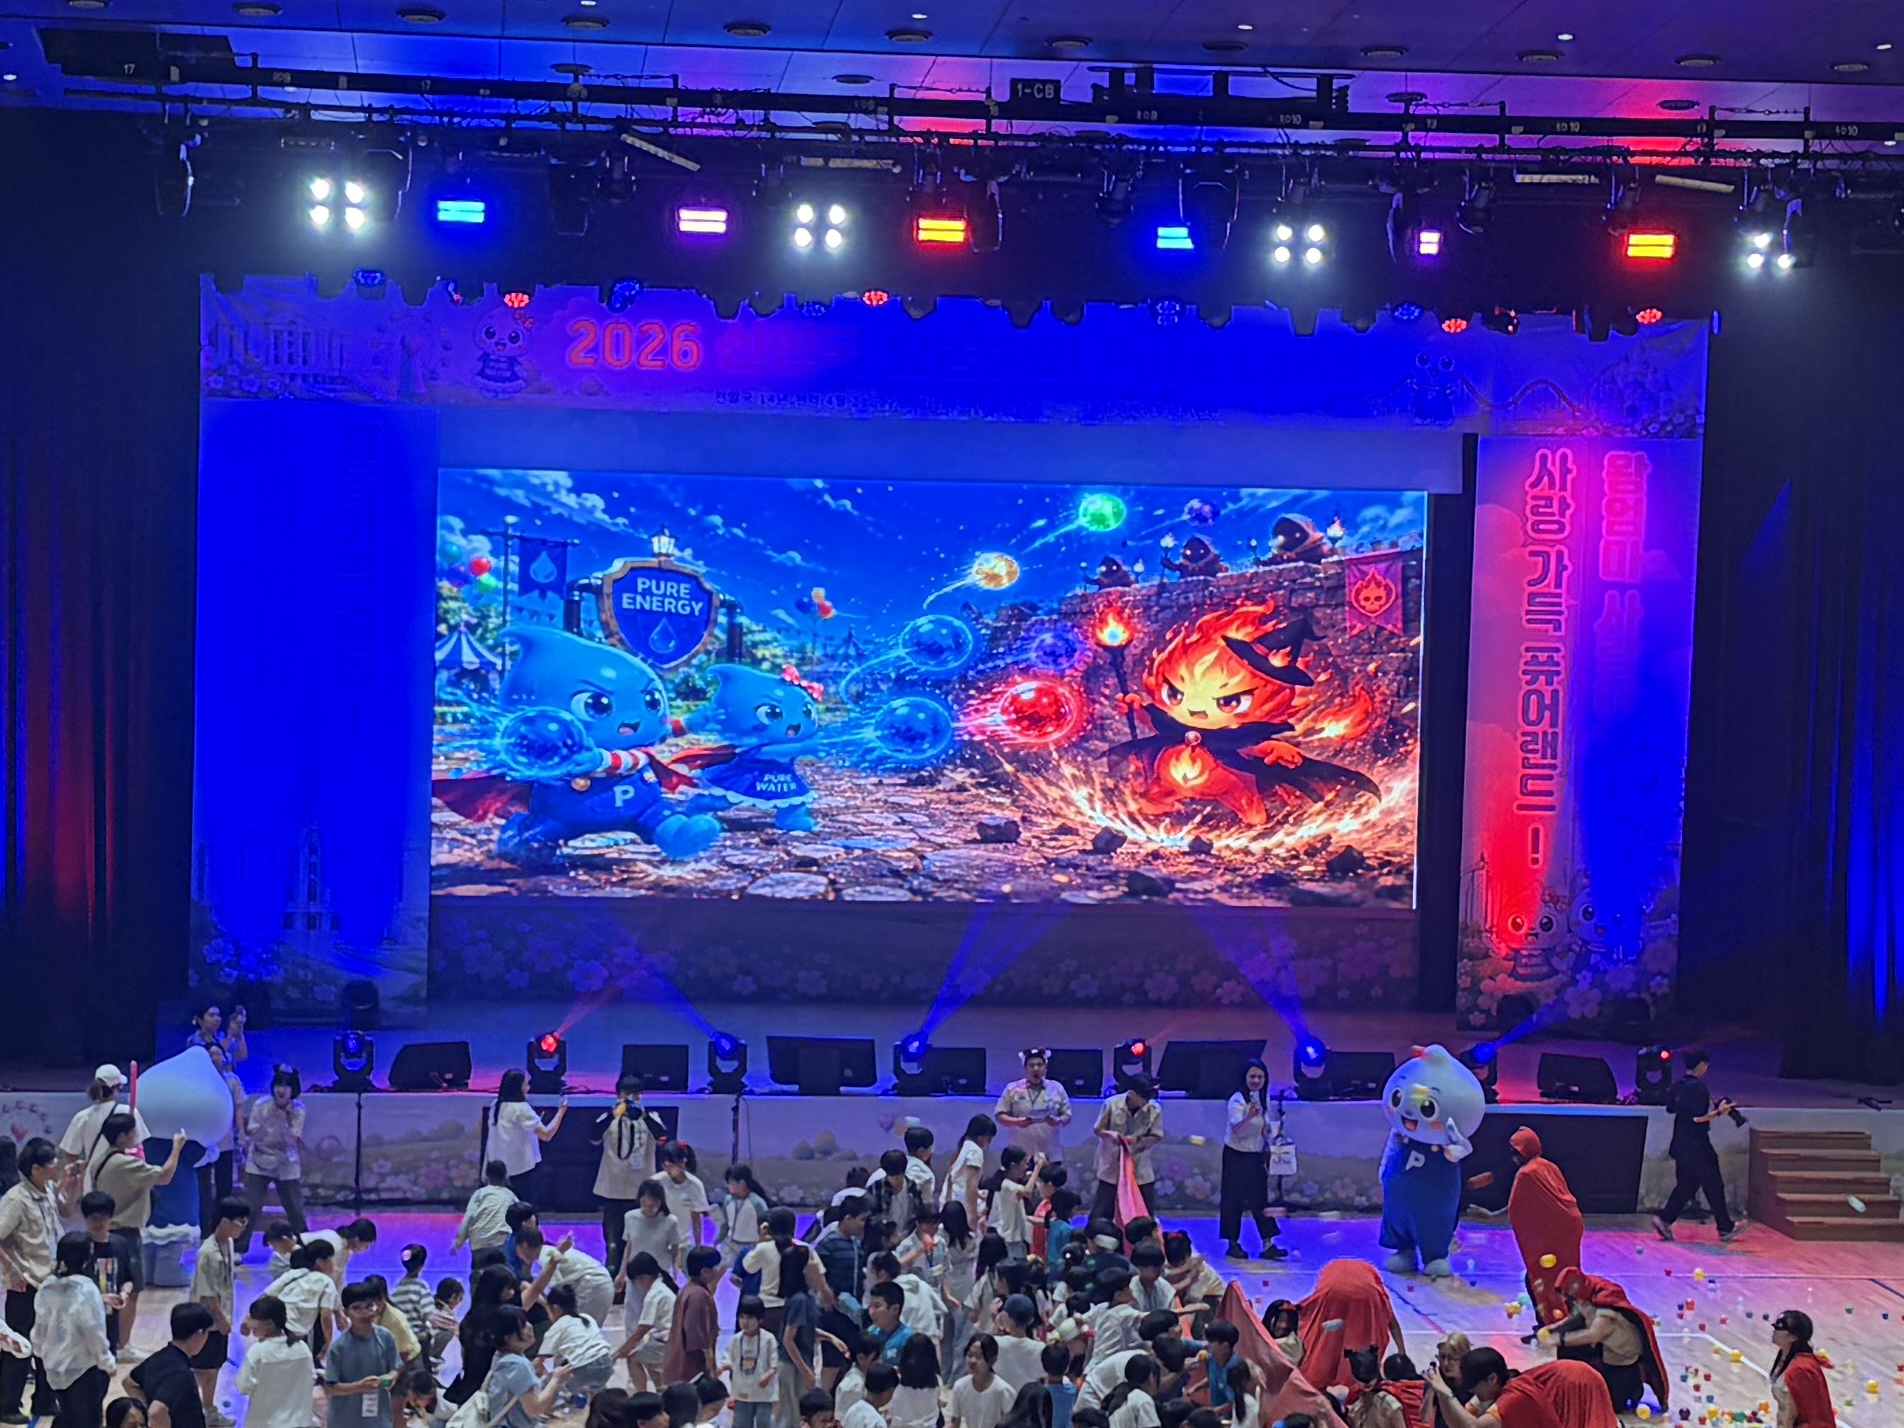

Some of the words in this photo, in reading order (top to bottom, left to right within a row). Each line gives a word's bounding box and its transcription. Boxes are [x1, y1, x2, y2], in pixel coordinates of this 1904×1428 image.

[1017, 83, 1055, 100] 1-CB
[567, 320, 701, 370] 2026
[1525, 448, 1577, 541] 사랑
[636, 576, 692, 600] PURE
[1523, 548, 1577, 636] 가득
[621, 592, 705, 618] ENERGY
[613, 785, 637, 808] P
[1405, 1149, 1426, 1171] P
